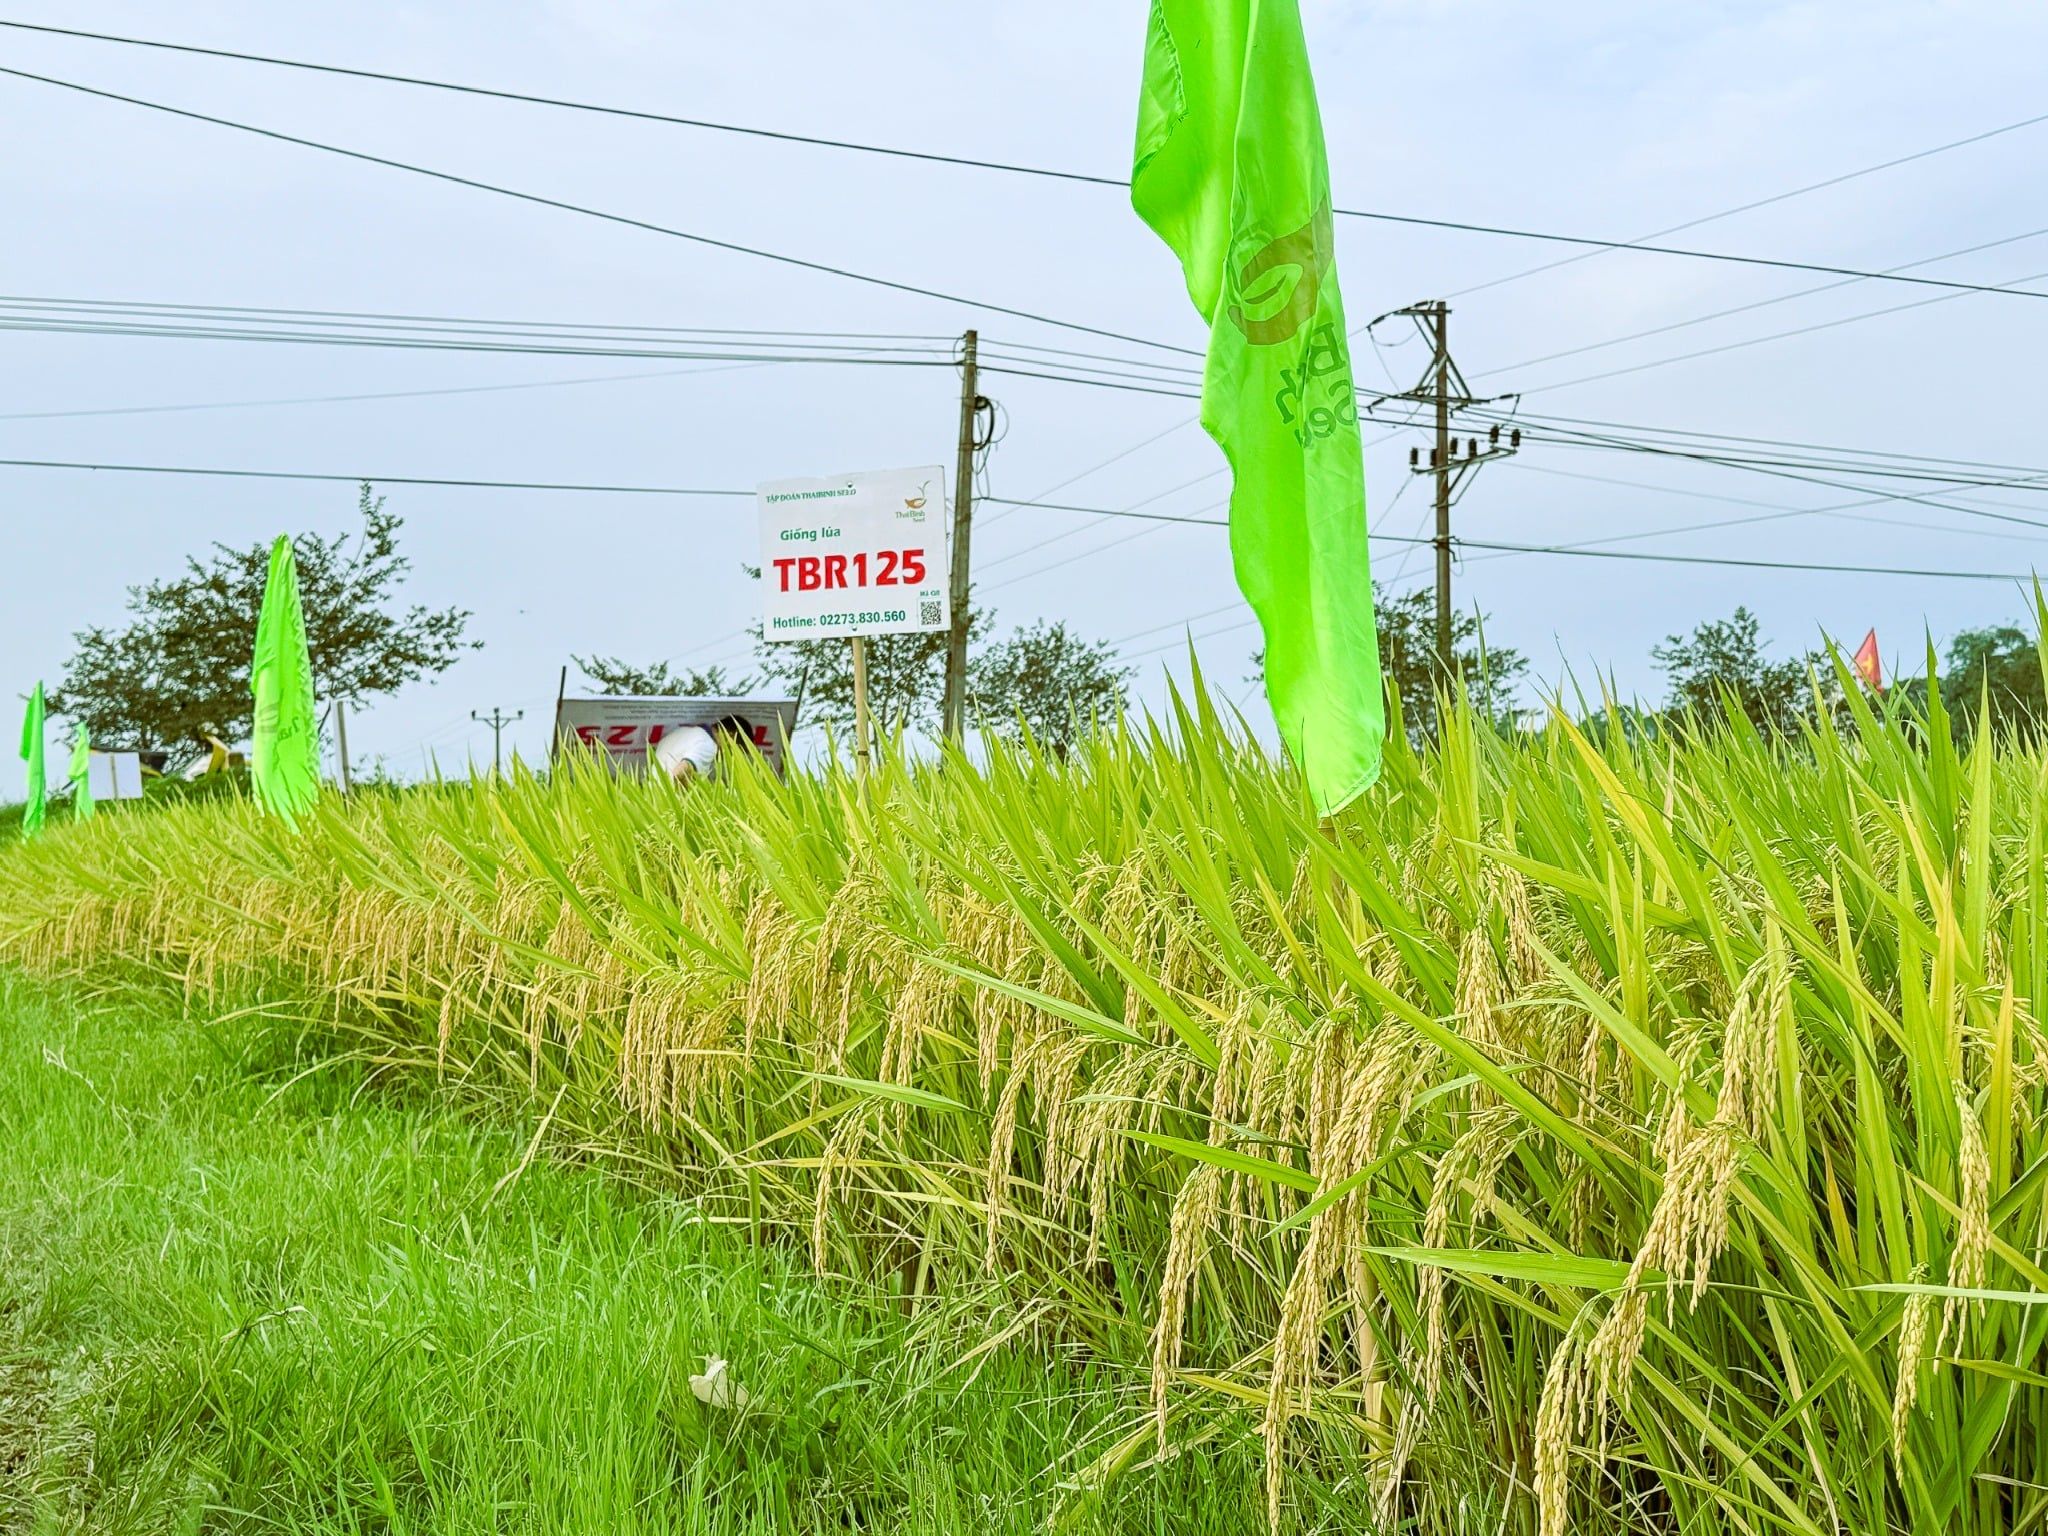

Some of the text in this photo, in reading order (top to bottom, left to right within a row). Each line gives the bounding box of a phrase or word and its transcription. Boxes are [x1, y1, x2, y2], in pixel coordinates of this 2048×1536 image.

[837, 488, 857, 497] SEED
[780, 526, 841, 542] Giống lúa
[773, 549, 926, 592] TBR125
[773, 610, 906, 629] Hotline: 02273.830.560
